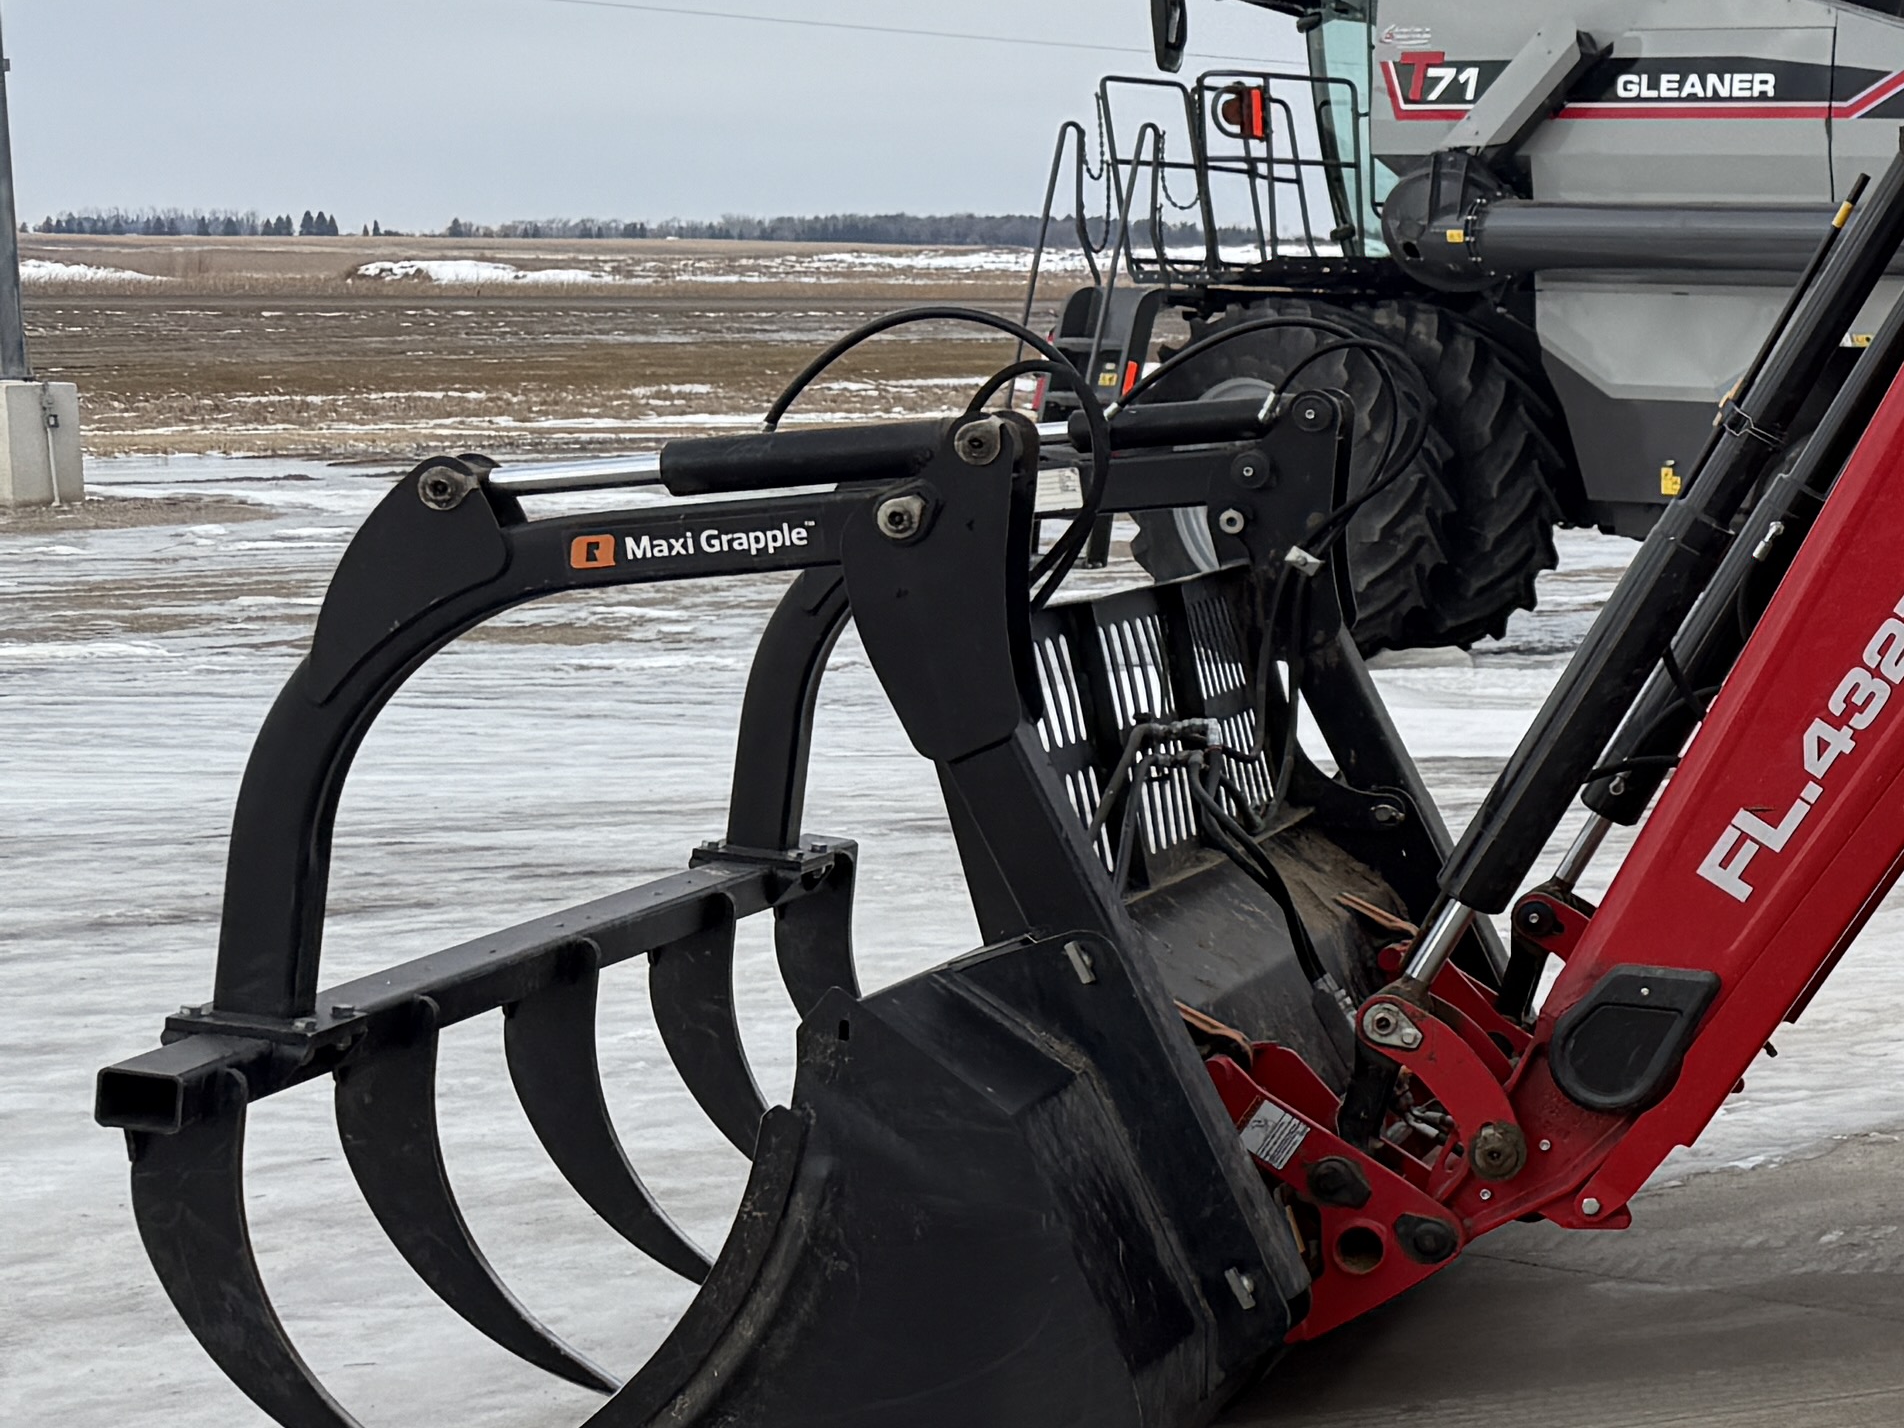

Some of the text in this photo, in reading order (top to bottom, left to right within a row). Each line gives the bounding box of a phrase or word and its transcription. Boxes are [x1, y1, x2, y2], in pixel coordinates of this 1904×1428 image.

[1400, 51, 1480, 101] T71
[1616, 73, 1776, 98] GLEANER
[625, 532, 694, 560] Maxi
